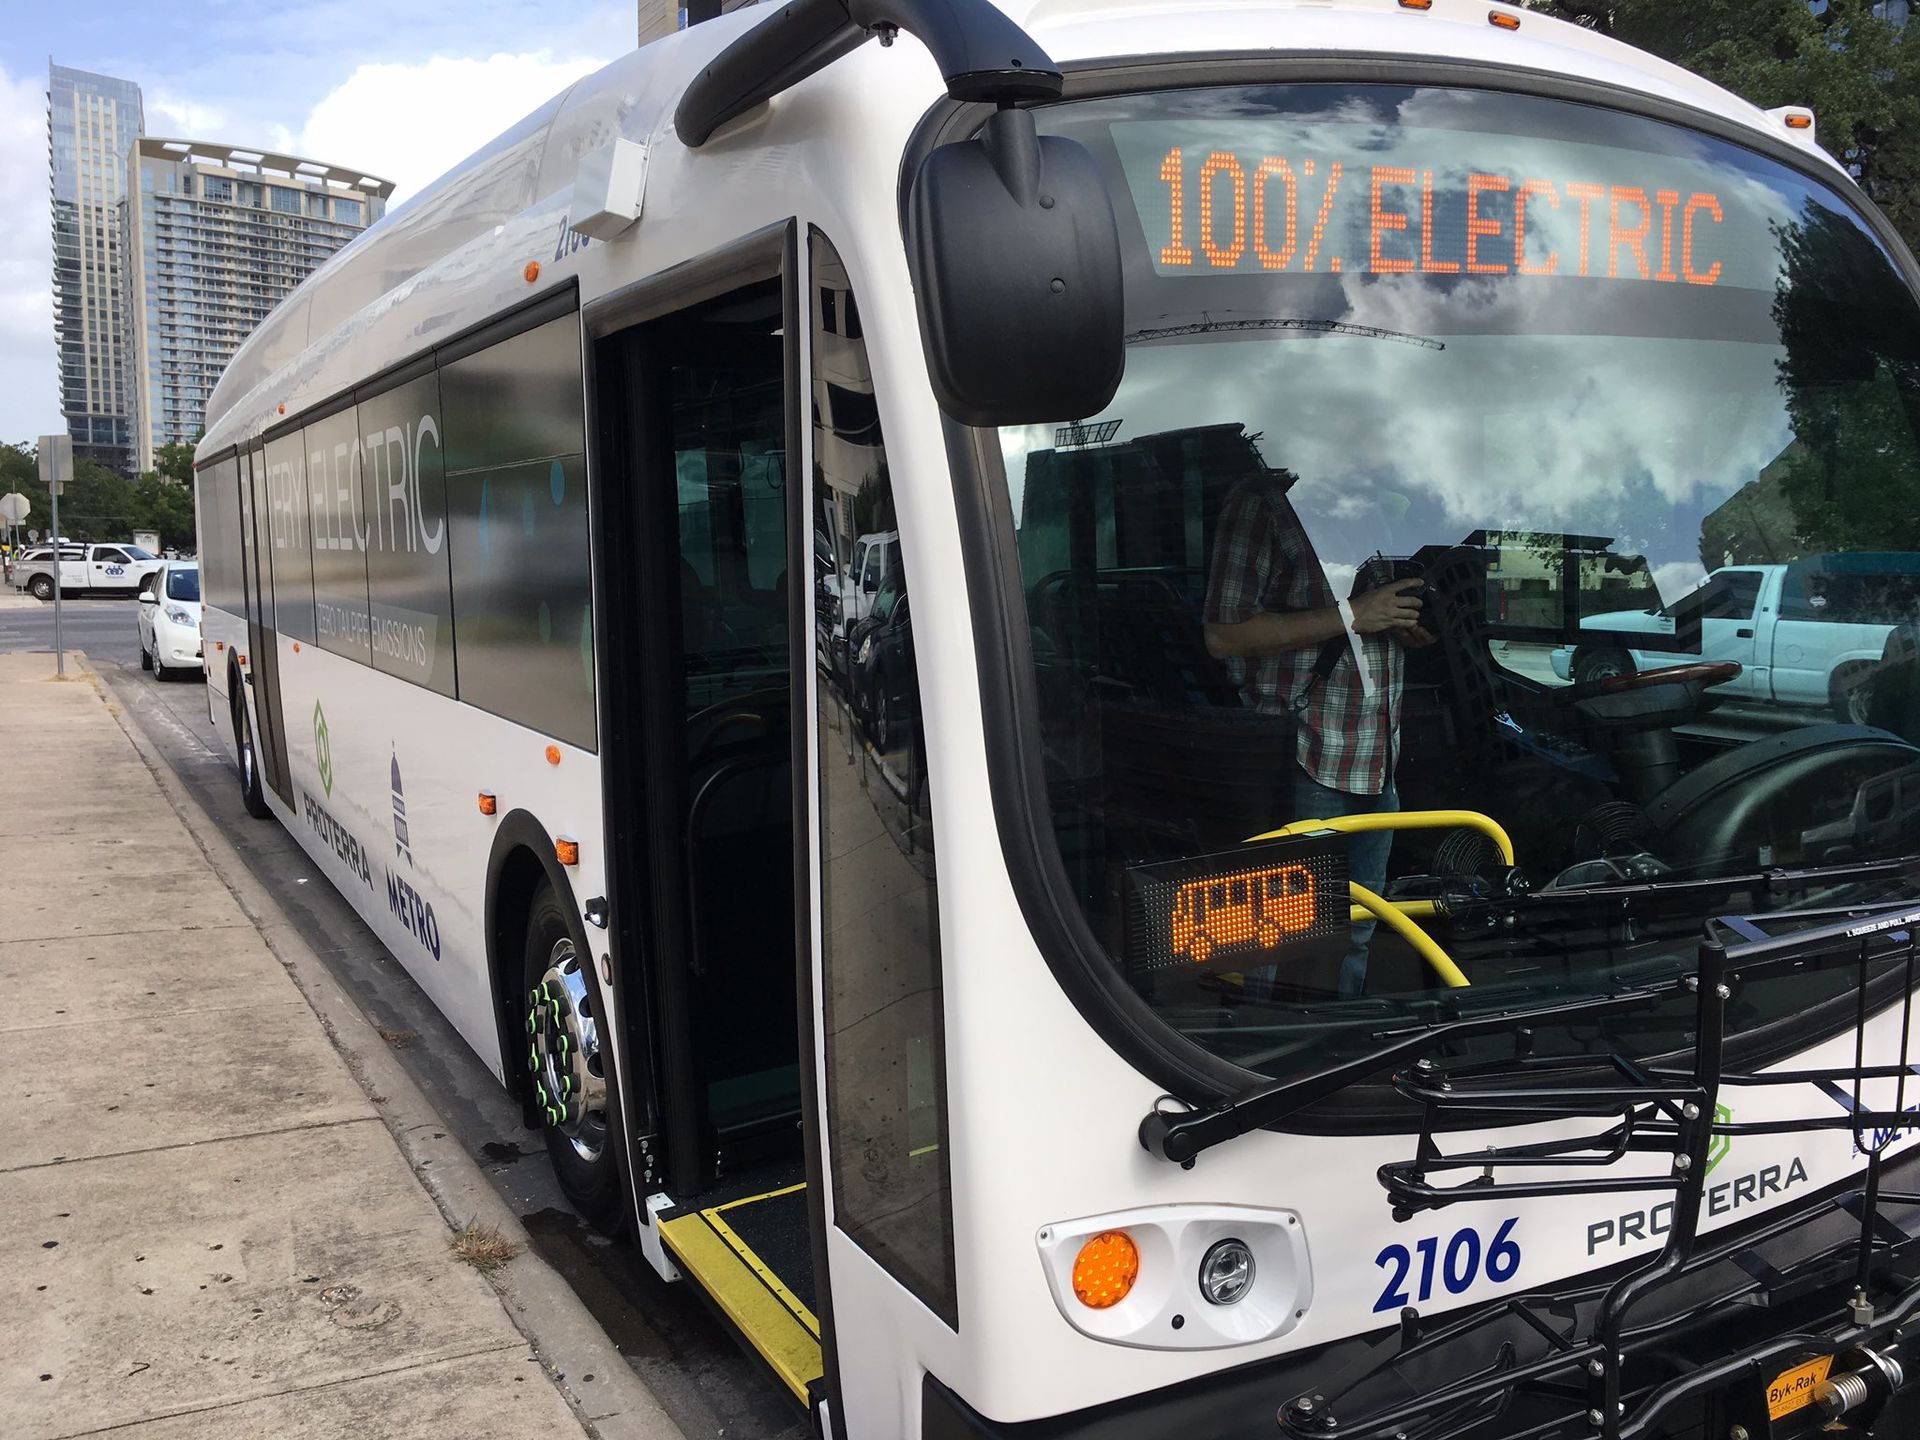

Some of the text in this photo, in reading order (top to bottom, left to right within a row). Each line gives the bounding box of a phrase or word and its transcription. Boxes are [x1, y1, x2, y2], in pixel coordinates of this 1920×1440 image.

[1161, 147, 1723, 285] 100% ELECTRIC
[310, 414, 445, 555] ELECTRIC
[317, 603, 337, 637] ZERO
[370, 616, 427, 667] EMISSIONS
[303, 791, 375, 892] PROTERRA
[385, 862, 441, 962] METRO
[1877, 920, 1890, 930] AND
[1588, 1156, 1809, 1257] PROERRA
[1372, 1217, 1521, 1314] 2106
[1769, 1372, 1817, 1403] Byk-Rak
